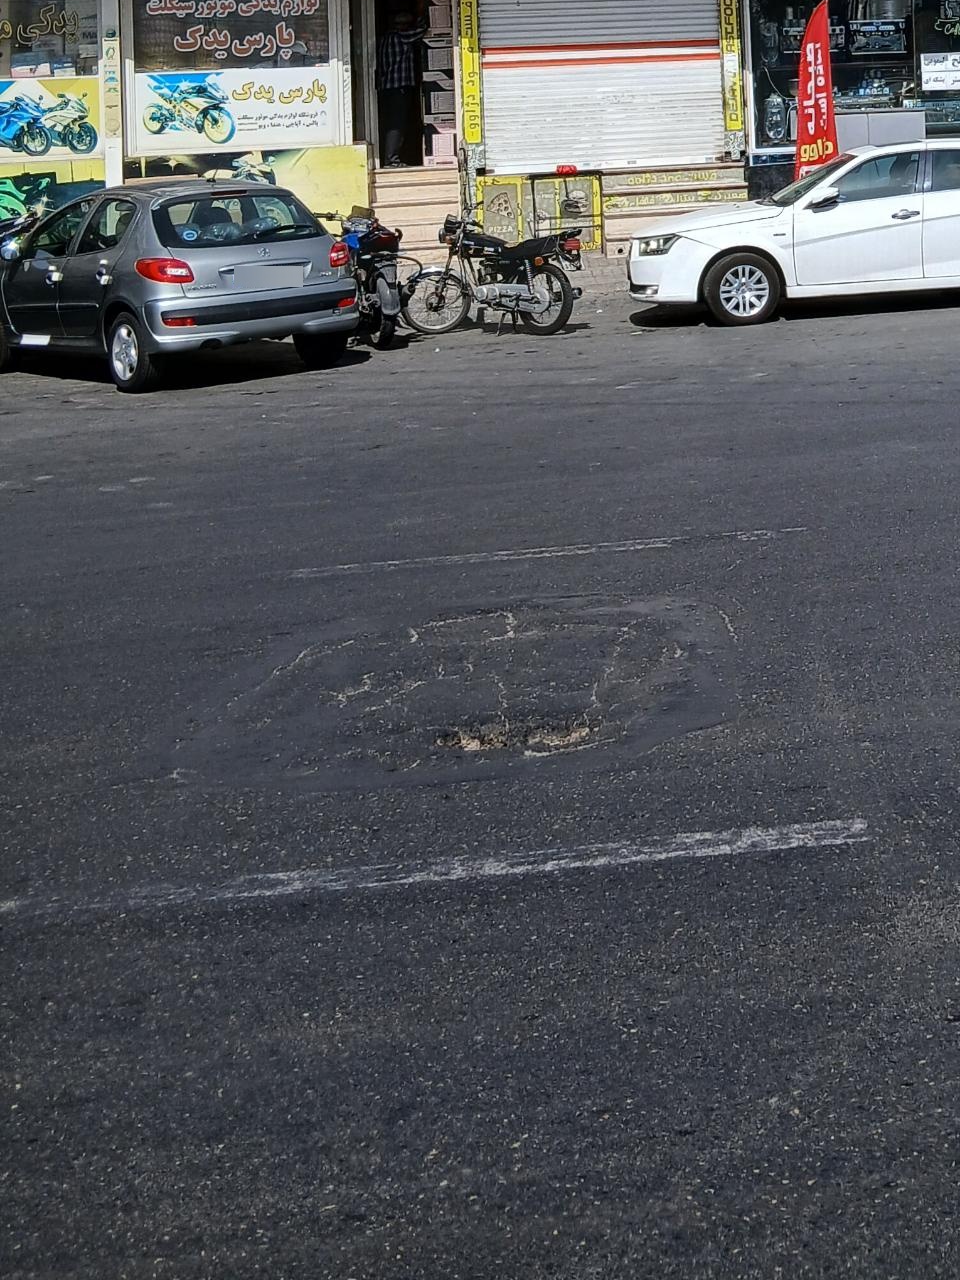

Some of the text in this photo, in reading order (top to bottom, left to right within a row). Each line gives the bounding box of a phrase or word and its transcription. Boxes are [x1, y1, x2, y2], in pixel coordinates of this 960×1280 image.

[174, 22, 295, 60] پارس یدک
[232, 78, 328, 104] پارس یدک
